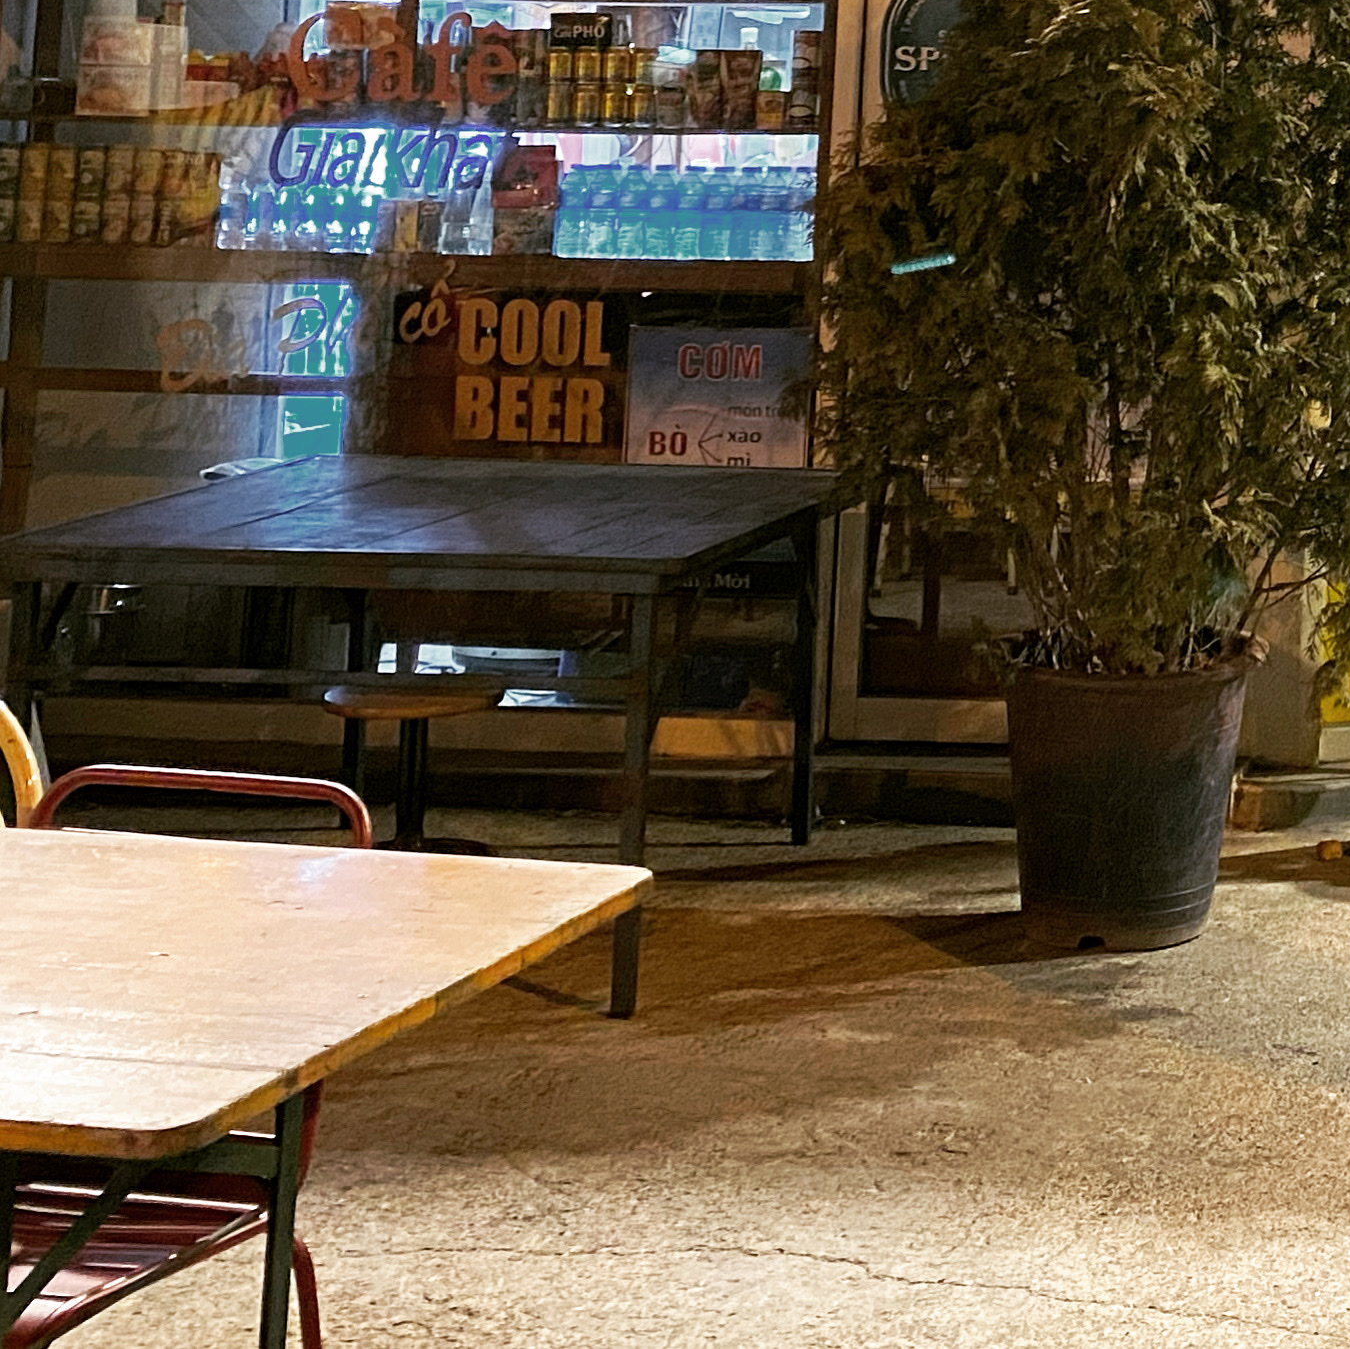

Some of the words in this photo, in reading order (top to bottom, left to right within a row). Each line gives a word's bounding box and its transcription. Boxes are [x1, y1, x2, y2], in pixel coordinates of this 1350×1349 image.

[458, 298, 610, 367] COOL
[454, 375, 605, 444] BEER
[648, 423, 688, 457] BÒ
